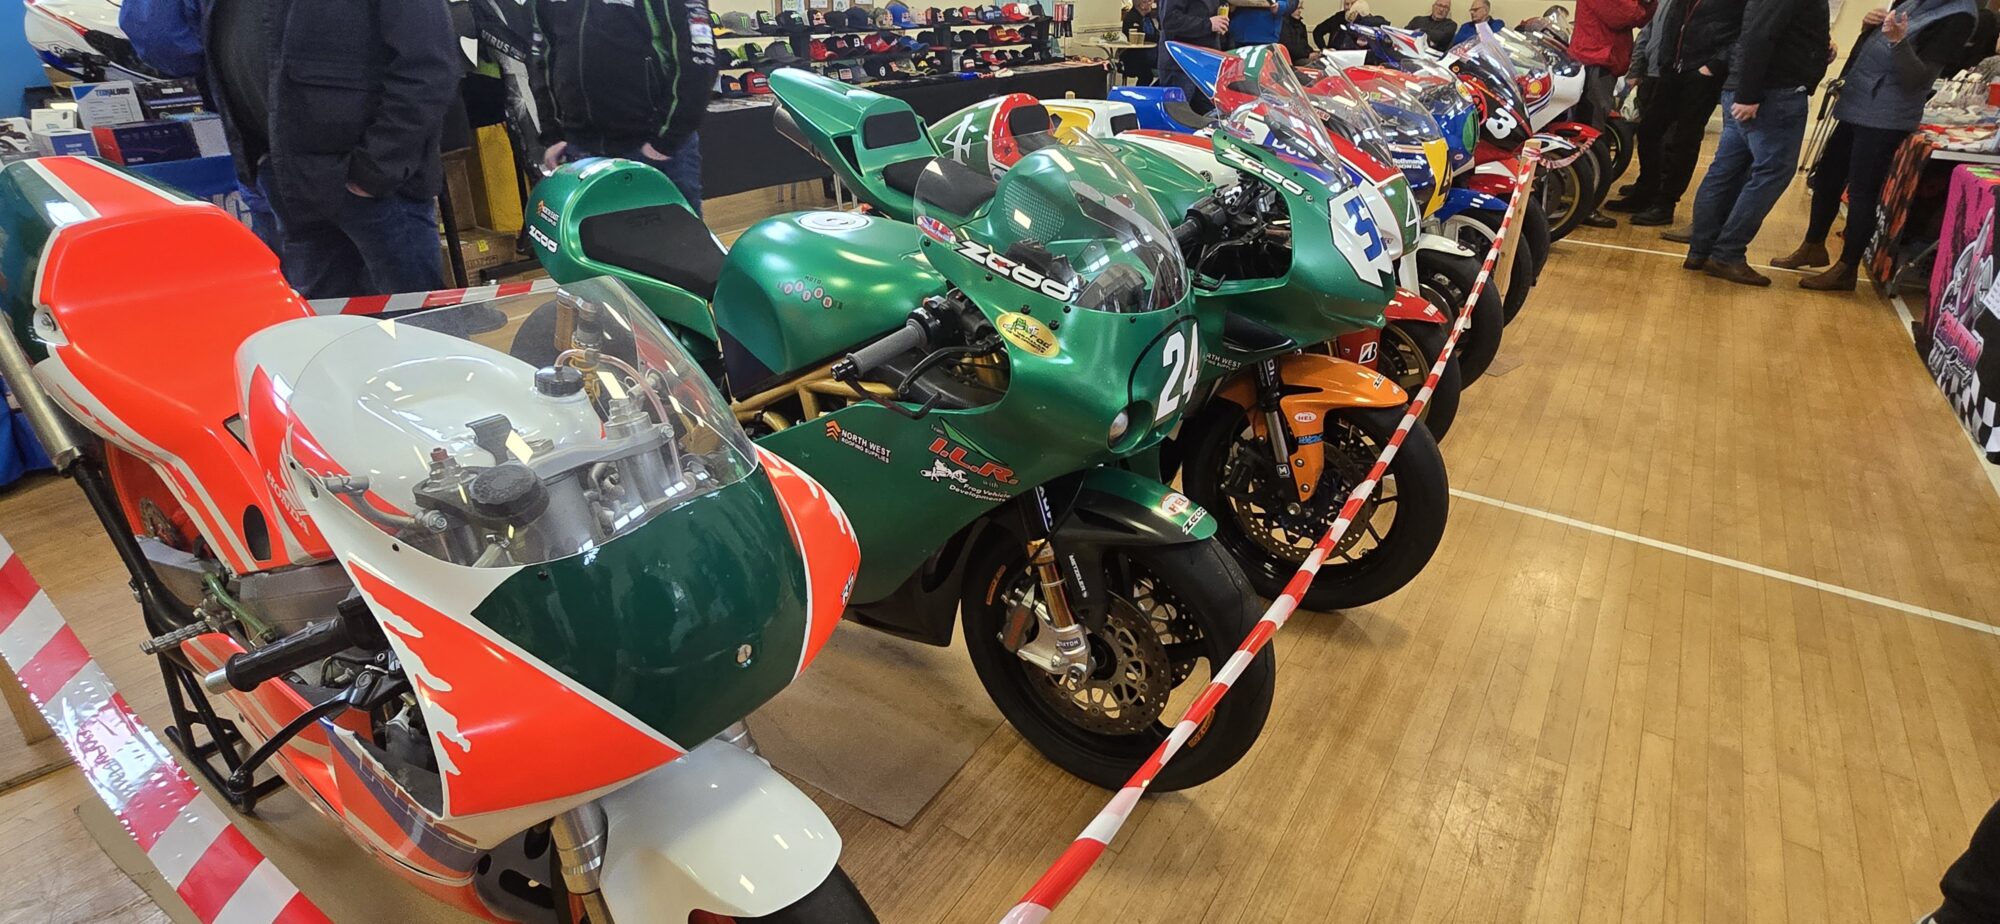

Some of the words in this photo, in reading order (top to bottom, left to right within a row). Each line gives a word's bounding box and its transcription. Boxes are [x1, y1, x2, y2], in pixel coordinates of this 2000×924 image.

[481, 29, 510, 53] VIRUS
[1486, 107, 1517, 139] 3
[942, 112, 974, 166] 4
[1222, 147, 1305, 196] ZCOO
[529, 224, 559, 253] ZCOO
[1344, 195, 1383, 262] 5
[804, 275, 822, 284] MOTO
[956, 240, 1073, 301] ZCOO
[1154, 322, 1199, 421] 24
[841, 429, 868, 447] NORTH
[869, 441, 891, 457] WEST
[841, 437, 864, 451] ROOFING
[864, 448, 890, 464] SUPPLIES
[949, 484, 1006, 502] Developments
[963, 483, 982, 494] Frog
[983, 489, 1011, 499] Vehicle
[983, 480, 999, 488] with
[266, 468, 311, 537] HONDA
[1168, 497, 1187, 513] HEL
